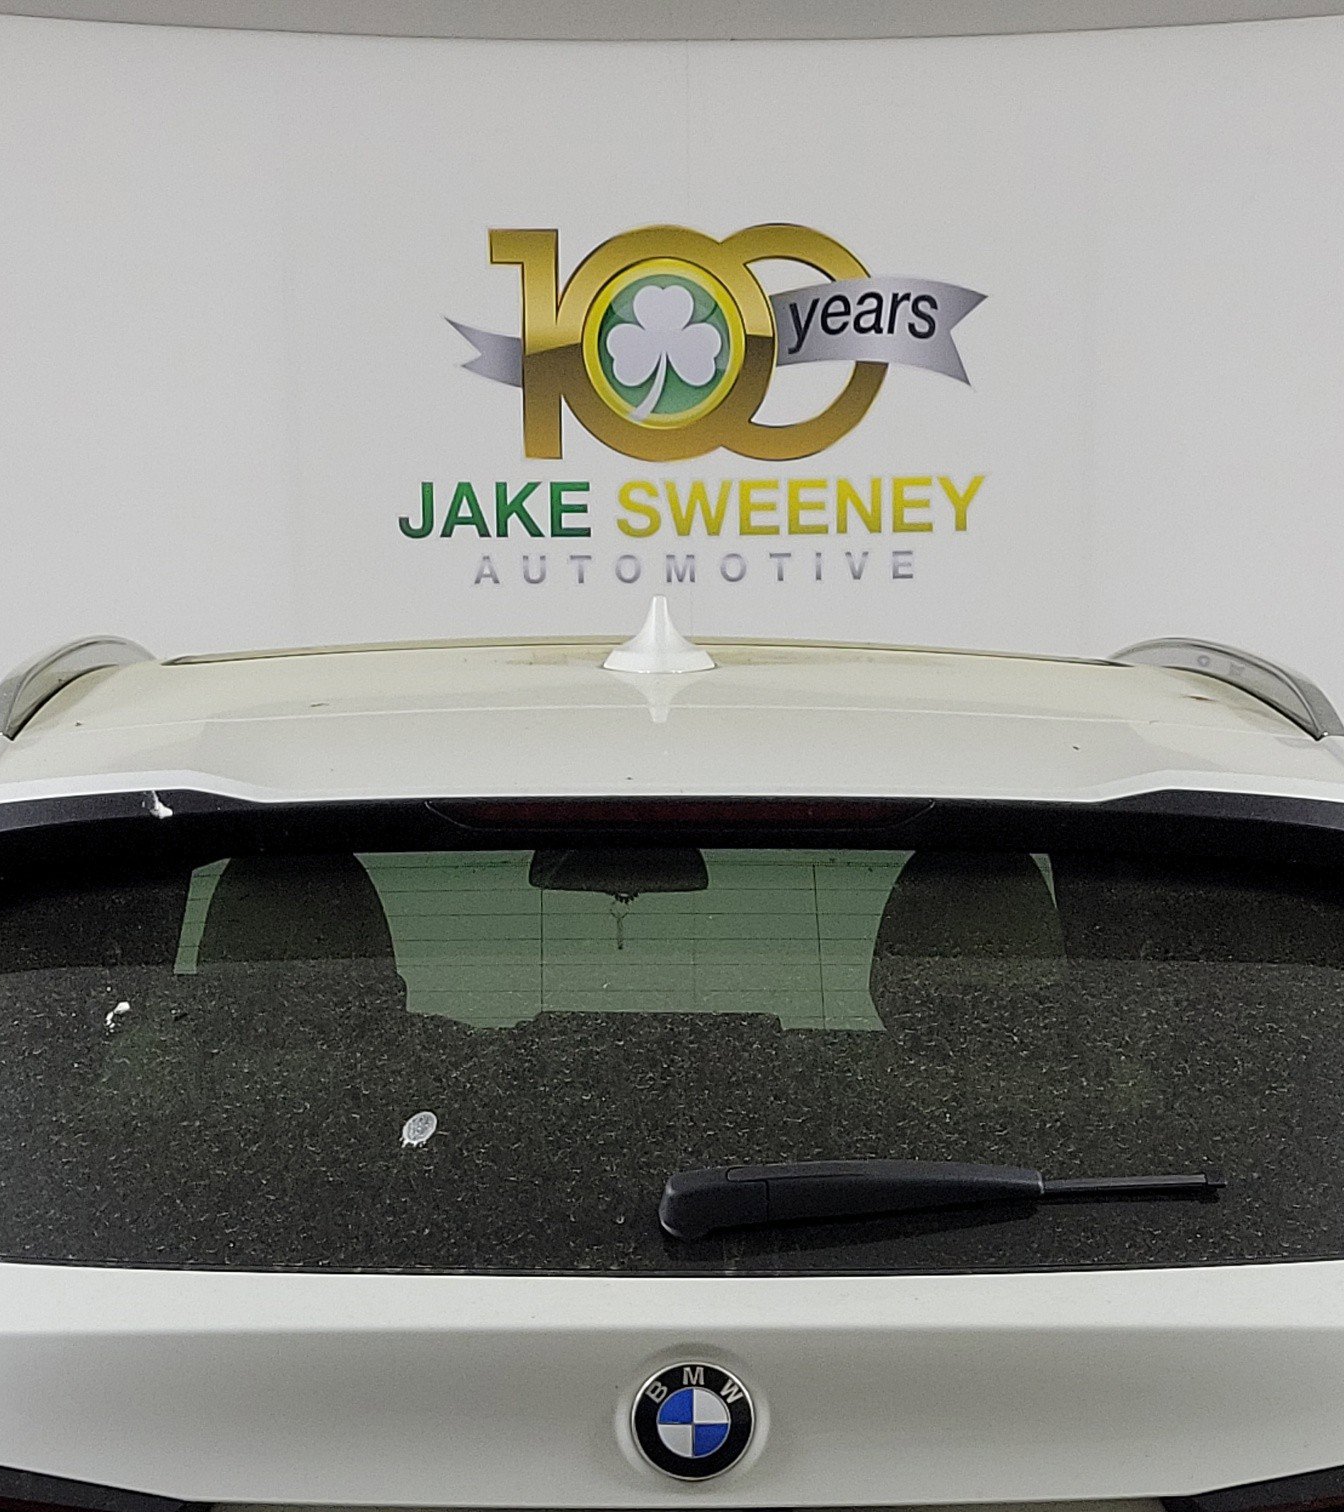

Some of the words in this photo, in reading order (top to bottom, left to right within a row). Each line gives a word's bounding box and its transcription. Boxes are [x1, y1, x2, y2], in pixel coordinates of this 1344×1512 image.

[488, 223, 888, 462] 100
[787, 290, 938, 354] years
[398, 481, 591, 540] JAKE
[616, 475, 986, 537] SWEENEY
[474, 550, 915, 585] AUTOMOTIVE
[645, 1366, 743, 1404] BMW
